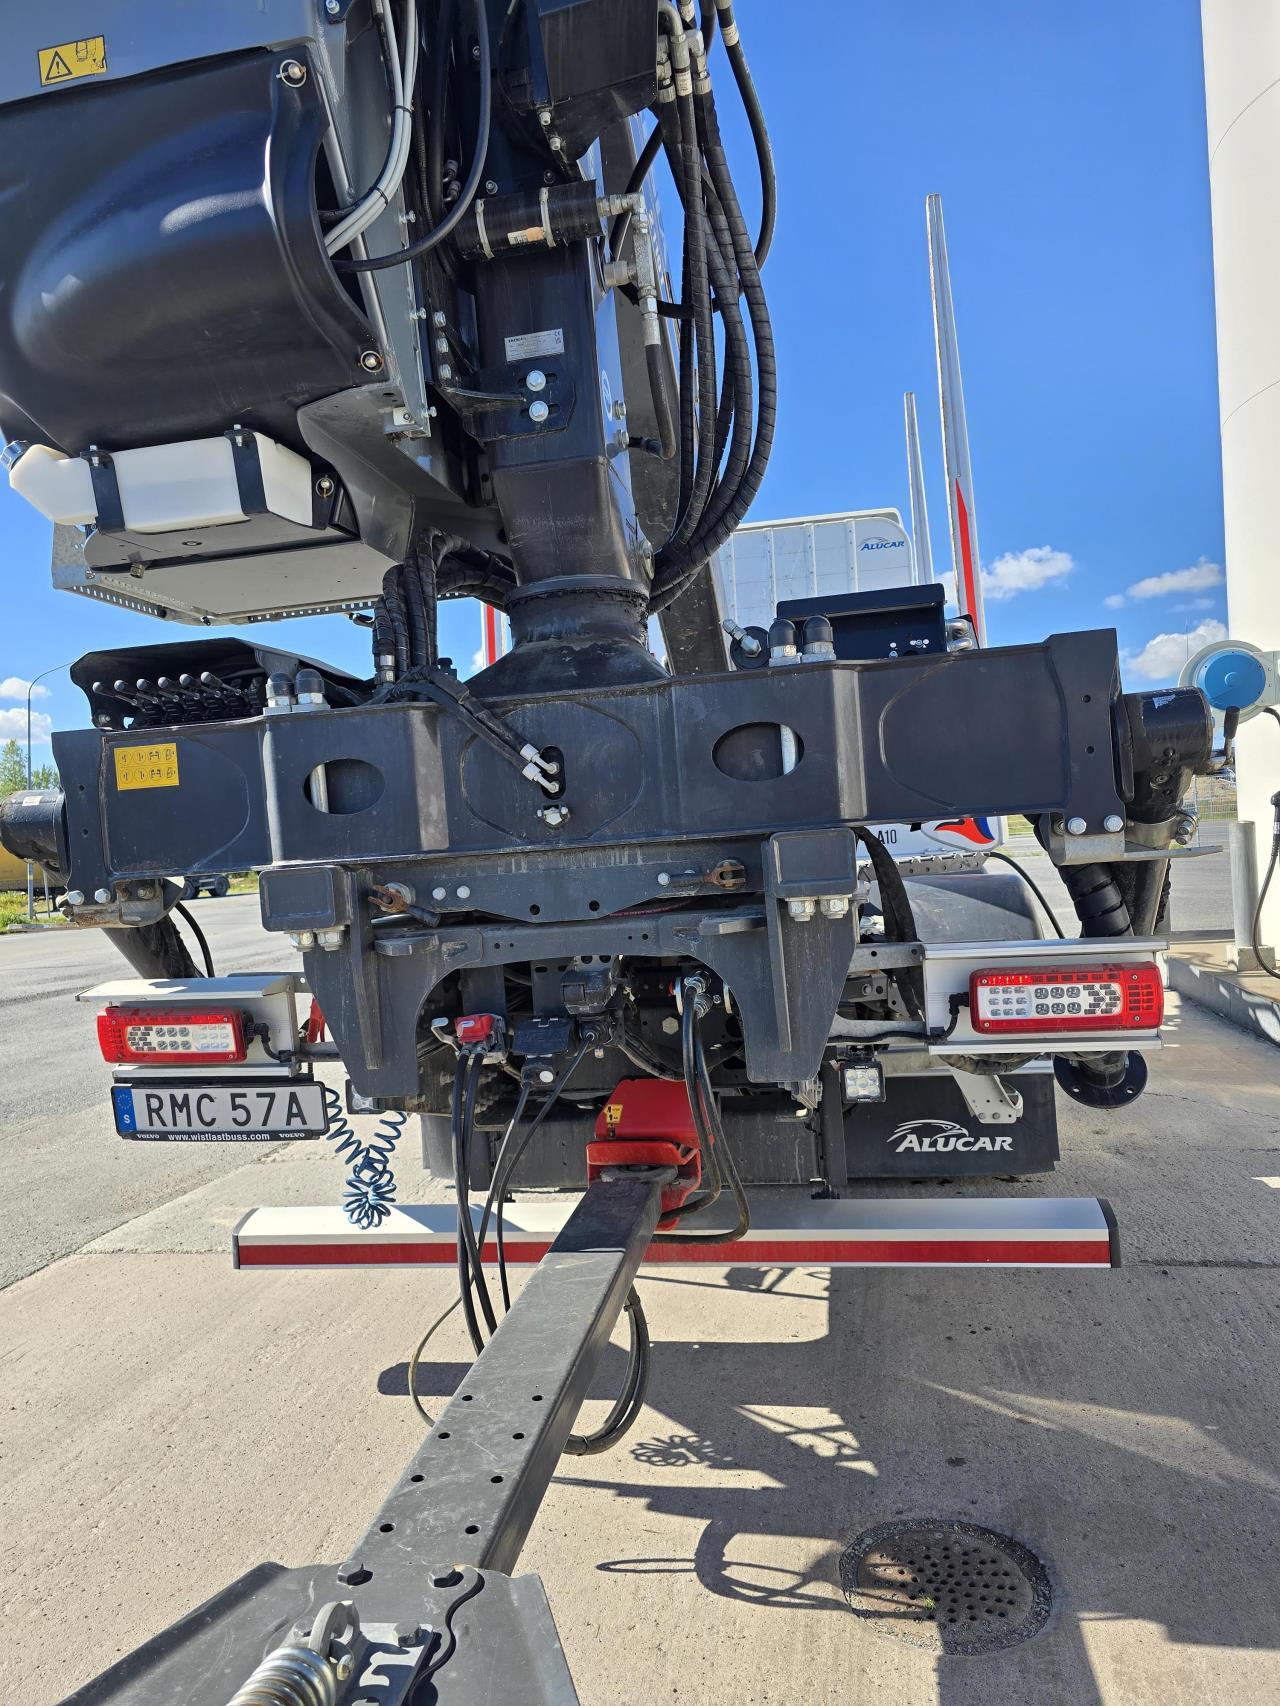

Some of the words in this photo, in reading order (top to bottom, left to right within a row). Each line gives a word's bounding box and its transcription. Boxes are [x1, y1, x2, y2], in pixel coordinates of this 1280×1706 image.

[860, 541, 905, 551] ALUCAR
[877, 829, 897, 844] A10
[145, 1093, 217, 1128] RMC
[230, 1091, 308, 1127] 57A
[123, 1114, 131, 1124] S
[167, 1132, 270, 1141] www.wistlastbuss.com
[895, 1134, 1013, 1152] ALUCAR
